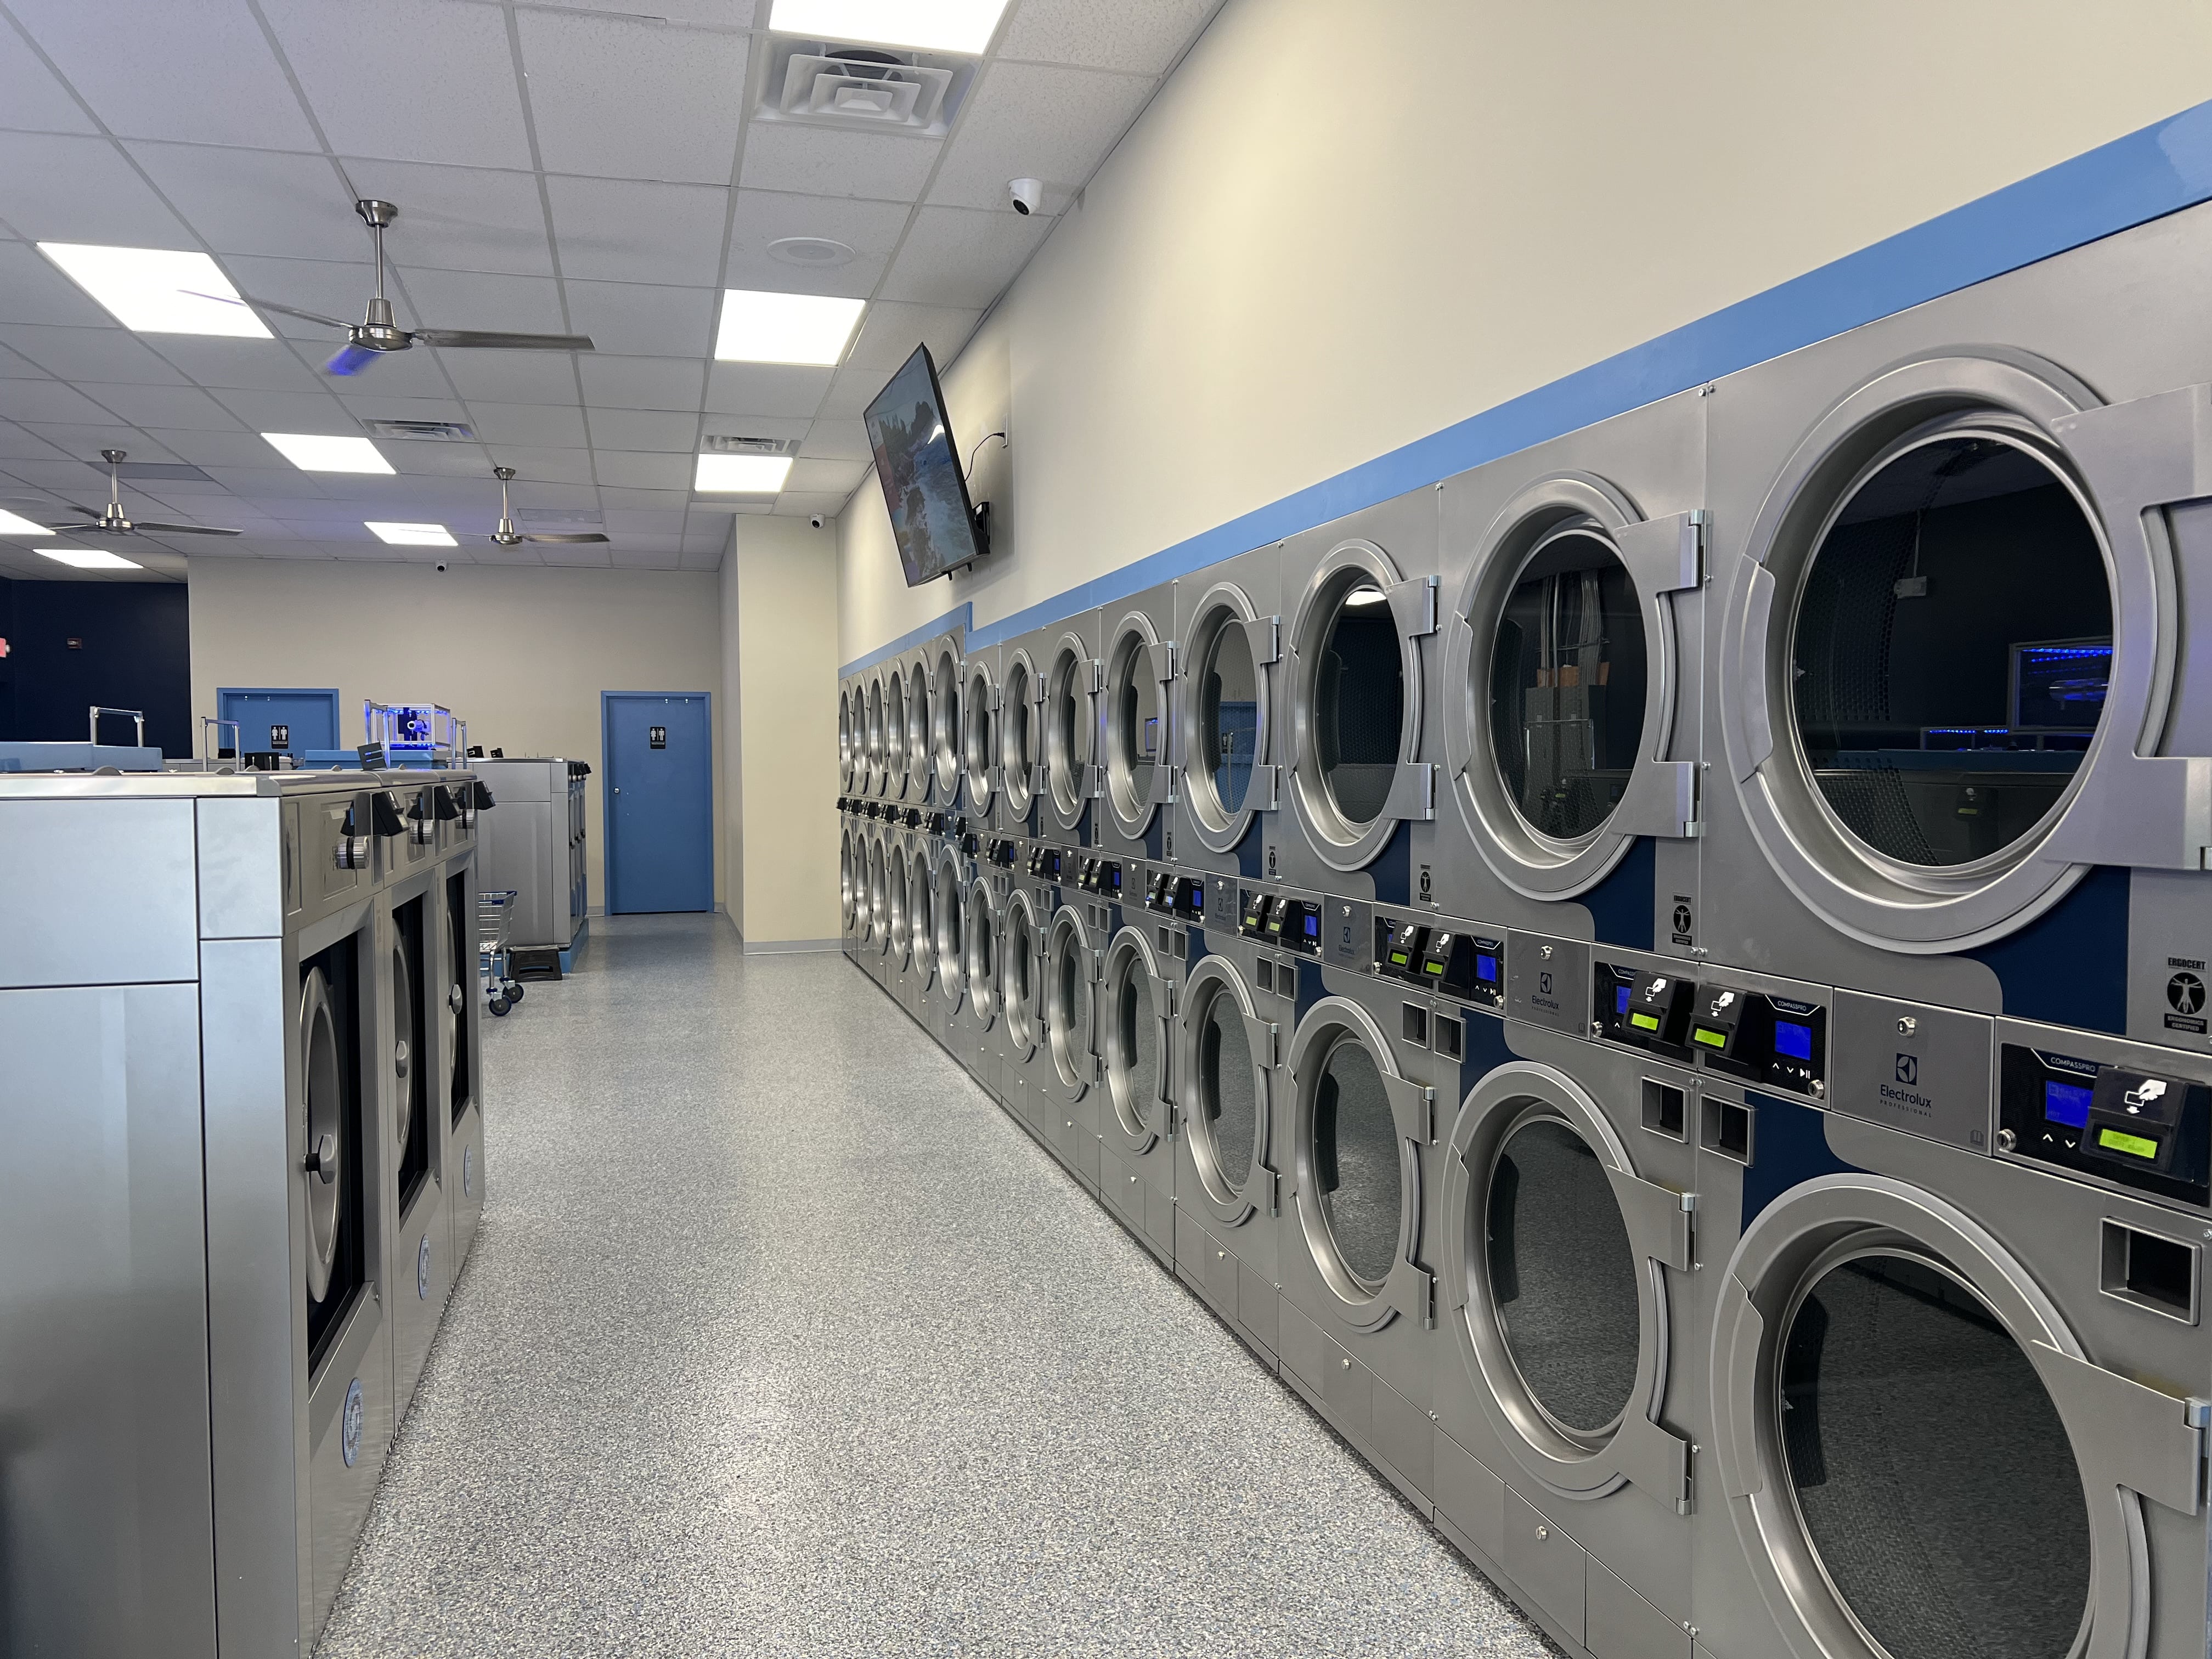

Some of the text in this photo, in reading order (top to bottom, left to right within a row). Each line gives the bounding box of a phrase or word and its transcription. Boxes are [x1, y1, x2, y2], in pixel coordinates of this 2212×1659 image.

[2168, 957, 2206, 970] ERGOCERT
[1532, 995, 1559, 1010] Electrolux
[2051, 1057, 2096, 1073] COMPASSPRO
[1880, 1084, 1932, 1109] Electrolux
[1880, 1099, 1932, 1118] PROFESSIONAL
